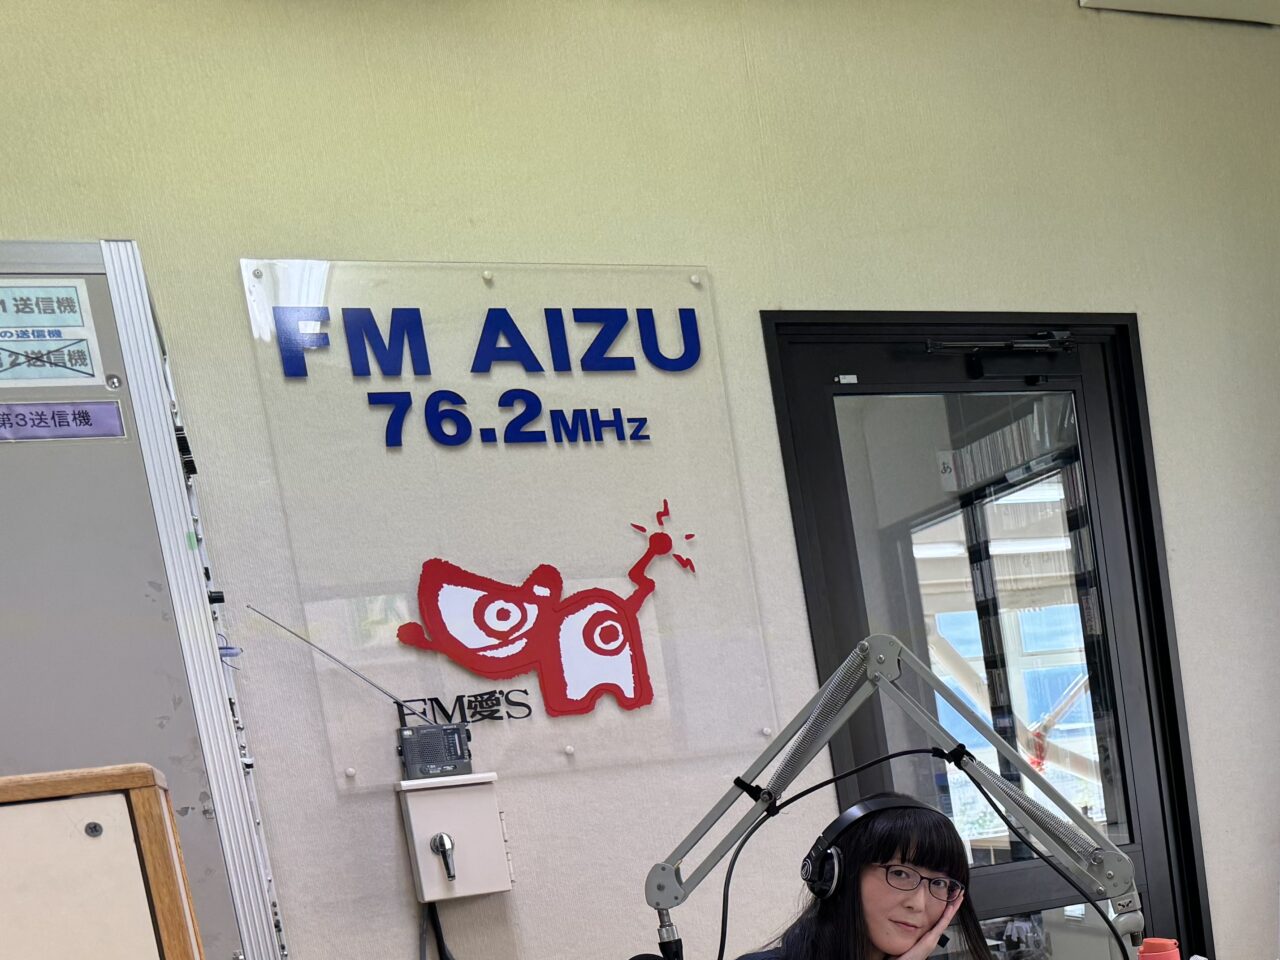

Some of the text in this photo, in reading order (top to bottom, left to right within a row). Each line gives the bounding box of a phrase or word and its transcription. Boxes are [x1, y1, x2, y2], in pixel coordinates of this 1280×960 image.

[0, 349, 88, 368] 2送信機
[272, 306, 701, 378] FM AIZU
